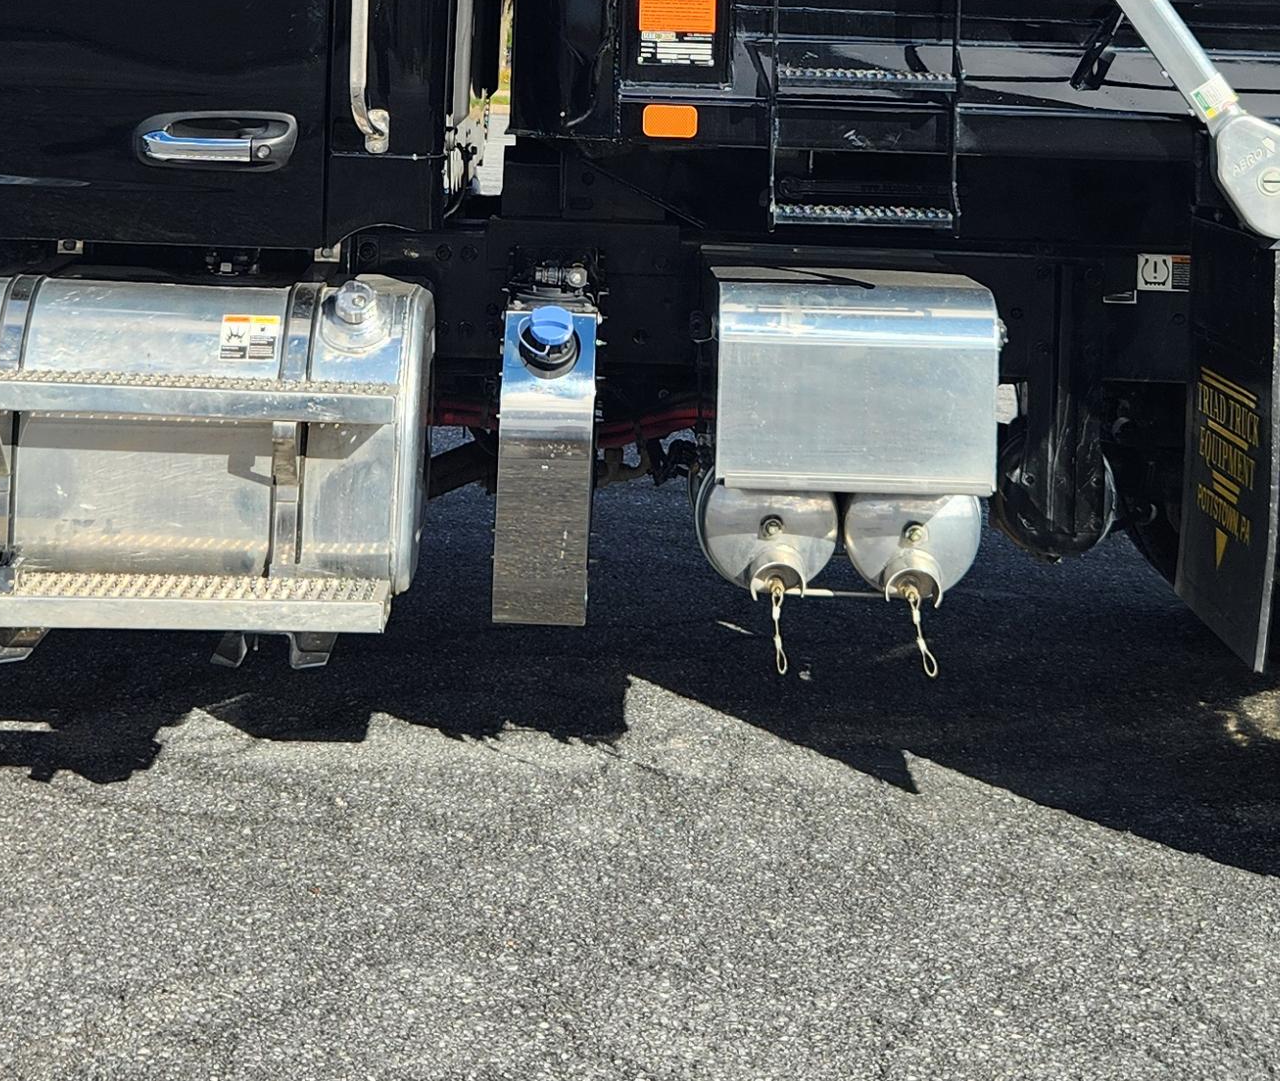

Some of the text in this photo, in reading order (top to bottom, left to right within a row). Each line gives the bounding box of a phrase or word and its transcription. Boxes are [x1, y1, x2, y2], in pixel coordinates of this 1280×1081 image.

[1232, 146, 1264, 178] AERO
[1197, 382, 1260, 448] TRIAD TRUCK
[1199, 425, 1256, 491] EQUIPMENT
[1240, 515, 1252, 546] PA
